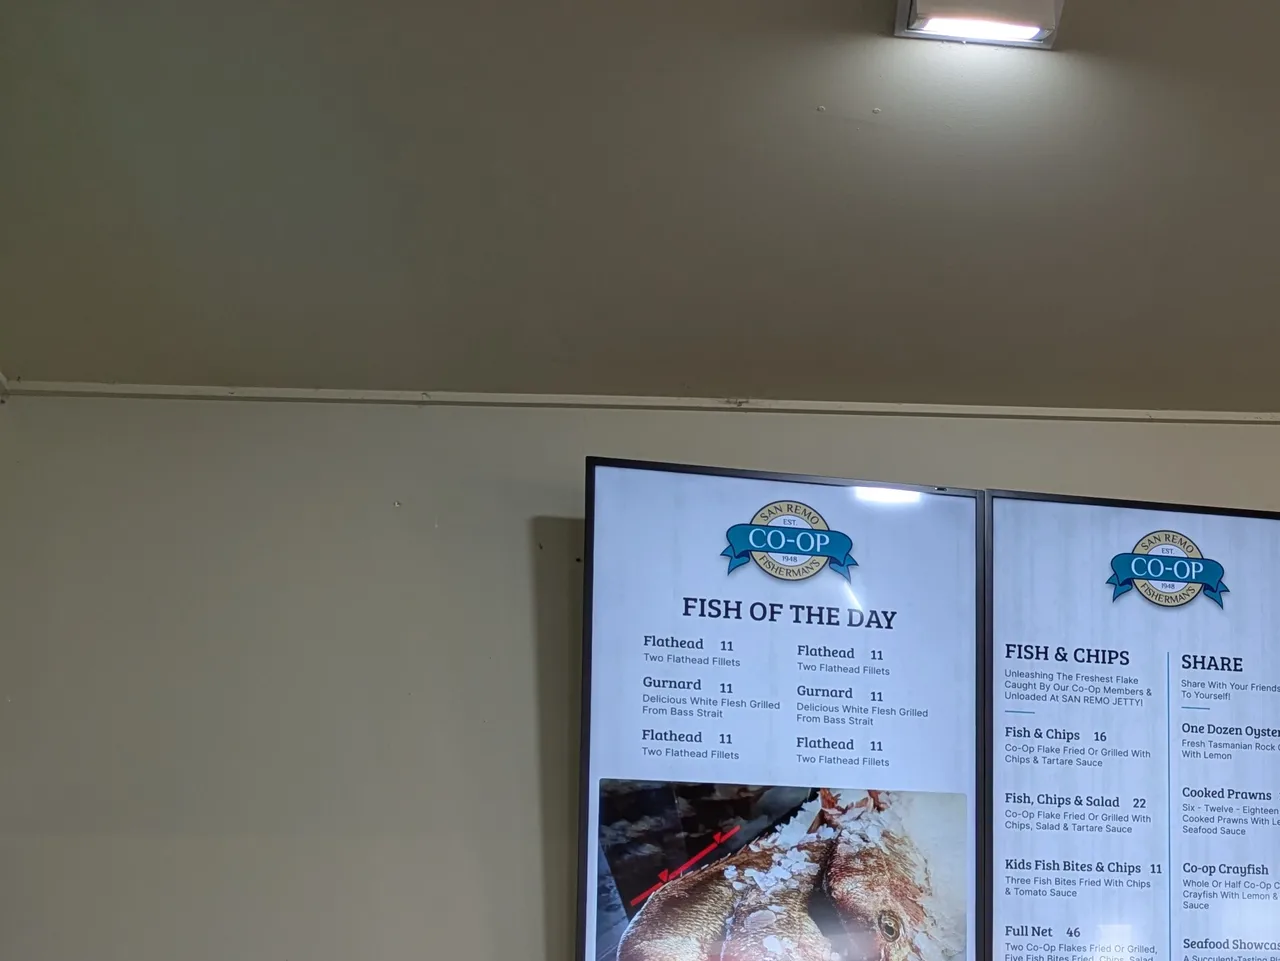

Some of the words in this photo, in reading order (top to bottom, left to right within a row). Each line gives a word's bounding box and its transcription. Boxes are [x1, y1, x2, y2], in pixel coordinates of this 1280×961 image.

[760, 504, 783, 521] SAN
[786, 503, 819, 525] REMO
[783, 518, 798, 526] EST.
[748, 528, 830, 553] CO-OP
[759, 555, 820, 577] FISHERMAN'S
[1130, 557, 1204, 581] CO-OP
[683, 597, 742, 619] FISH
[750, 602, 783, 622] OF
[790, 605, 840, 626] THE
[847, 609, 897, 629] DAY
[644, 635, 704, 649] Flathead
[721, 641, 733, 651] 11
[644, 653, 664, 662] Two
[667, 654, 709, 665] Flathead
[712, 657, 740, 667] Fillets
[1005, 644, 1049, 660] FISH
[1055, 647, 1068, 662] &
[1074, 648, 1129, 665] CHIPS
[1182, 654, 1243, 672] SHARE
[643, 676, 701, 690] Gurnard
[720, 683, 733, 693] 11
[643, 694, 687, 707] Delicious
[690, 697, 718, 706] White
[721, 698, 746, 707] Flesh
[750, 700, 780, 709] Grilled
[1005, 691, 1048, 701] Unloaded
[1050, 694, 1059, 702] At
[1062, 694, 1080, 703] SAN
[1084, 696, 1110, 705] REMO
[1112, 697, 1143, 706] JETTY!
[642, 706, 667, 715] From
[670, 707, 694, 716] Bass
[697, 709, 723, 718] Strait
[1005, 727, 1031, 738] Fish
[1034, 728, 1043, 739] &
[1046, 729, 1080, 743] Chips
[1094, 732, 1107, 742] 16
[1182, 723, 1204, 734] One
[1207, 724, 1243, 735] Dozen
[1005, 792, 1034, 805] Fish,
[1037, 794, 1071, 808] Chips
[1074, 796, 1083, 806] &
[1086, 796, 1120, 807] Salad
[1133, 798, 1146, 808] 22
[1182, 787, 1225, 798] Cooked
[1227, 789, 1272, 800] Prawns
[1005, 859, 1032, 870] Kids
[1035, 860, 1060, 871] Fish
[1063, 860, 1092, 872] Bites
[1095, 862, 1104, 872] &
[1107, 862, 1141, 876] Chips
[1150, 864, 1162, 874] 11
[1183, 863, 1216, 876] Co-op
[1219, 864, 1269, 877] Crayfish
[1005, 925, 1028, 936] Full
[1031, 926, 1053, 937] Net
[1066, 927, 1080, 937] 46
